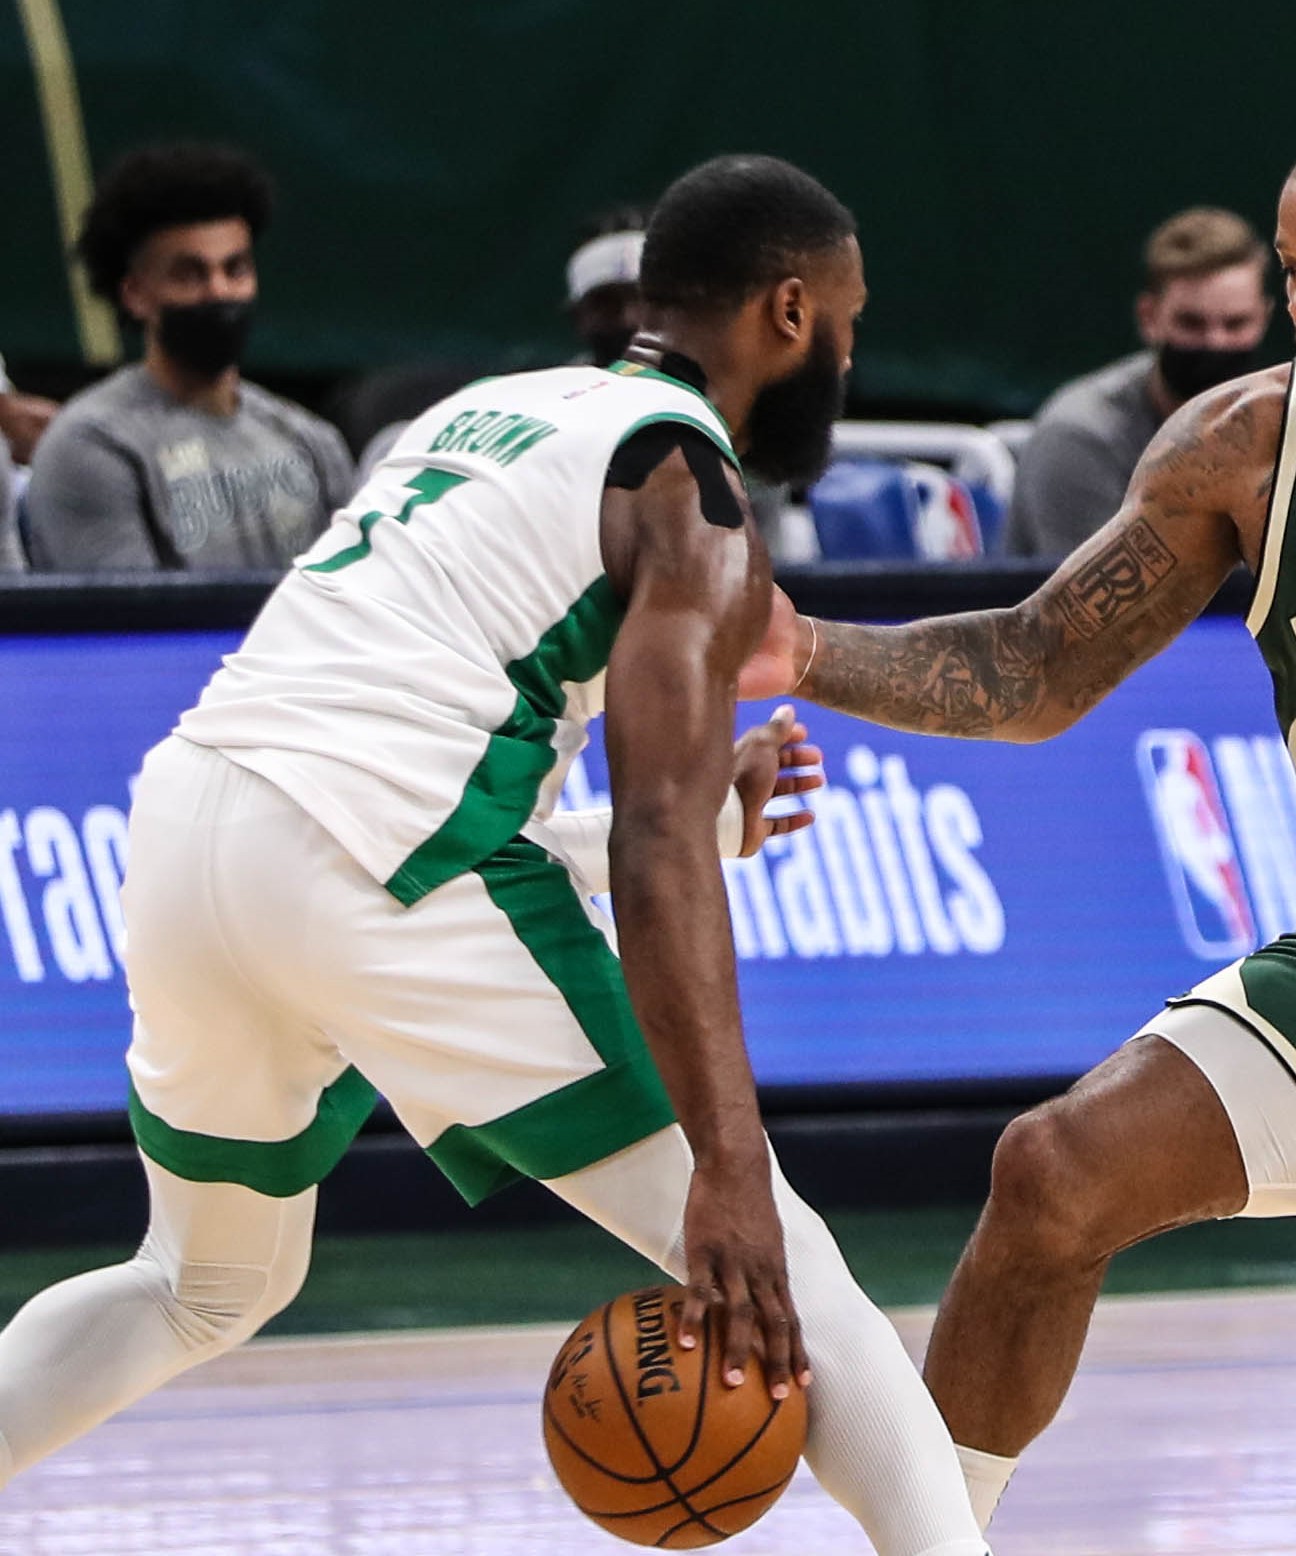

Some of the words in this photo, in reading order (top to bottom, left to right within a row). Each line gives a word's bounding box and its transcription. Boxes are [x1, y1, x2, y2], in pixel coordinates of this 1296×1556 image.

[426, 410, 559, 468] BROWN
[299, 467, 473, 573] 7
[1129, 524, 1171, 566] RUFF
